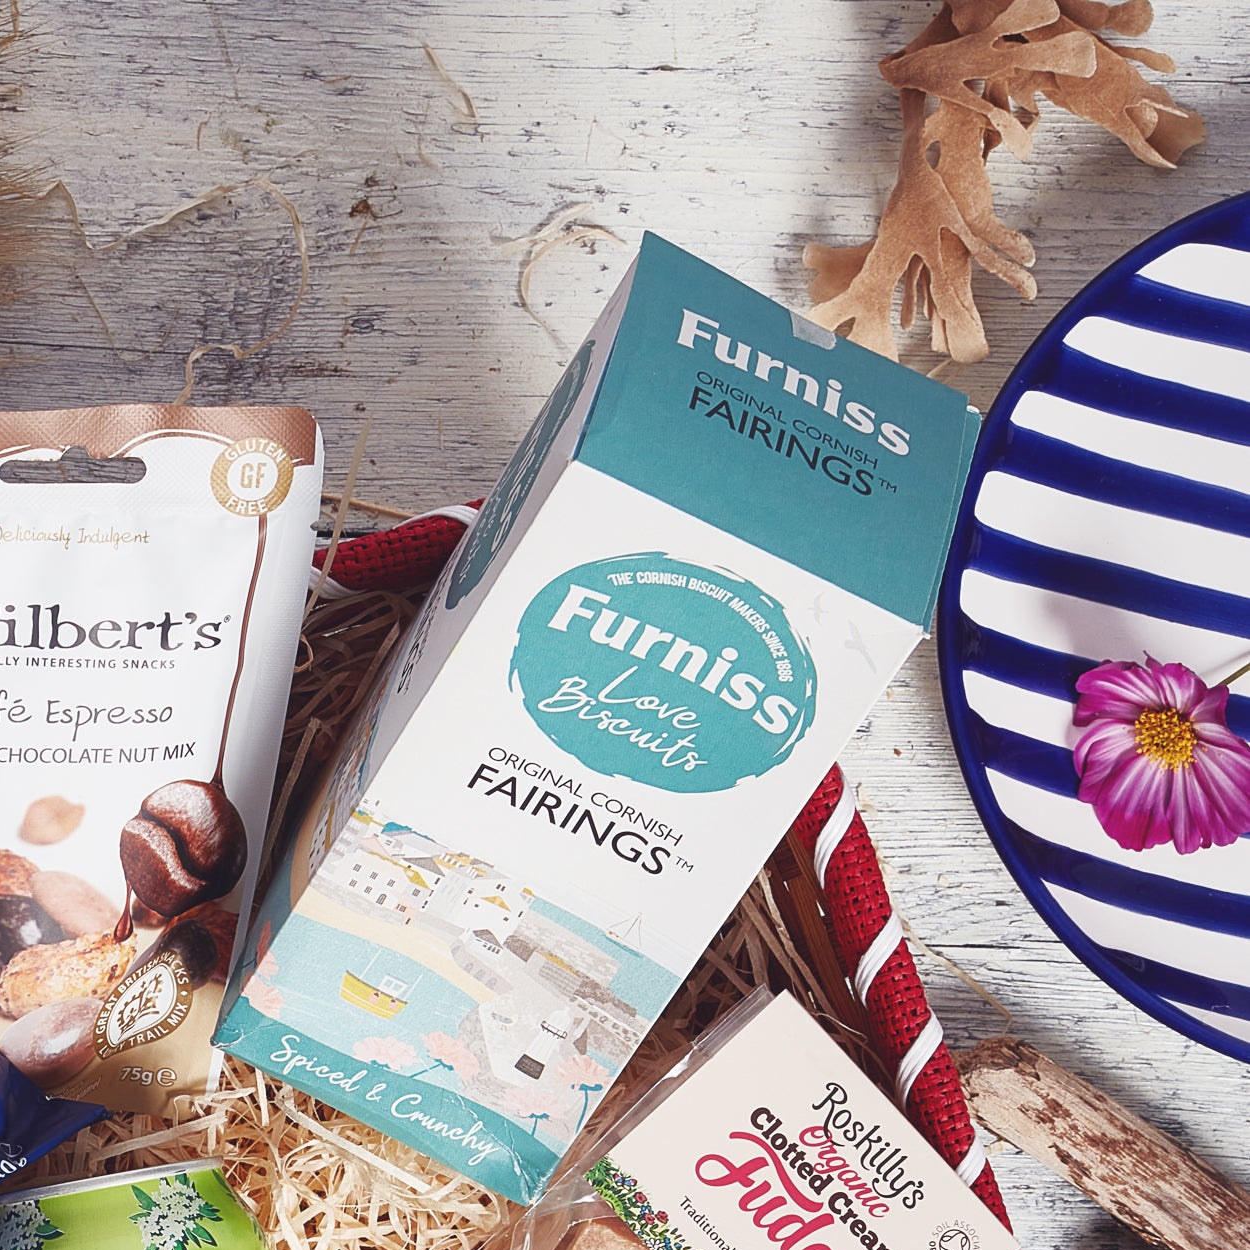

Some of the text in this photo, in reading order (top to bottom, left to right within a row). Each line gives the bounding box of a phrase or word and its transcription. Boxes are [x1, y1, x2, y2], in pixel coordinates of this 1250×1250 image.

[675, 308, 911, 457] Furniss
[696, 371, 878, 470] ORIGINAL CORNISH
[225, 439, 287, 463] GLUTEN
[240, 462, 267, 488] GF
[77, 526, 150, 550] Indulgent
[225, 496, 268, 515] FREE
[26, 657, 116, 669] INTERESTING
[123, 659, 176, 670] SNACKS
[547, 583, 798, 735] Furniss
[607, 571, 793, 682] THE CORNISH BISCUIT MAKERS SINCE 1886
[45, 700, 173, 741] Espresso
[537, 675, 708, 771] Biscuits
[598, 665, 701, 729] Love
[119, 746, 159, 763] NUT
[163, 741, 197, 761] MIX
[487, 746, 683, 848] ORIGINAL CORNISH
[96, 951, 189, 1034] GREAT BRITISH SNACKS
[129, 1002, 189, 1046] TRAIL MIX
[269, 1034, 501, 1167] Spiced & Crunchy
[750, 1107, 834, 1196] Clotted
[798, 1125, 890, 1218] Organic
[811, 1082, 925, 1210] Roskilly's
[932, 1221, 951, 1238] SOIL
